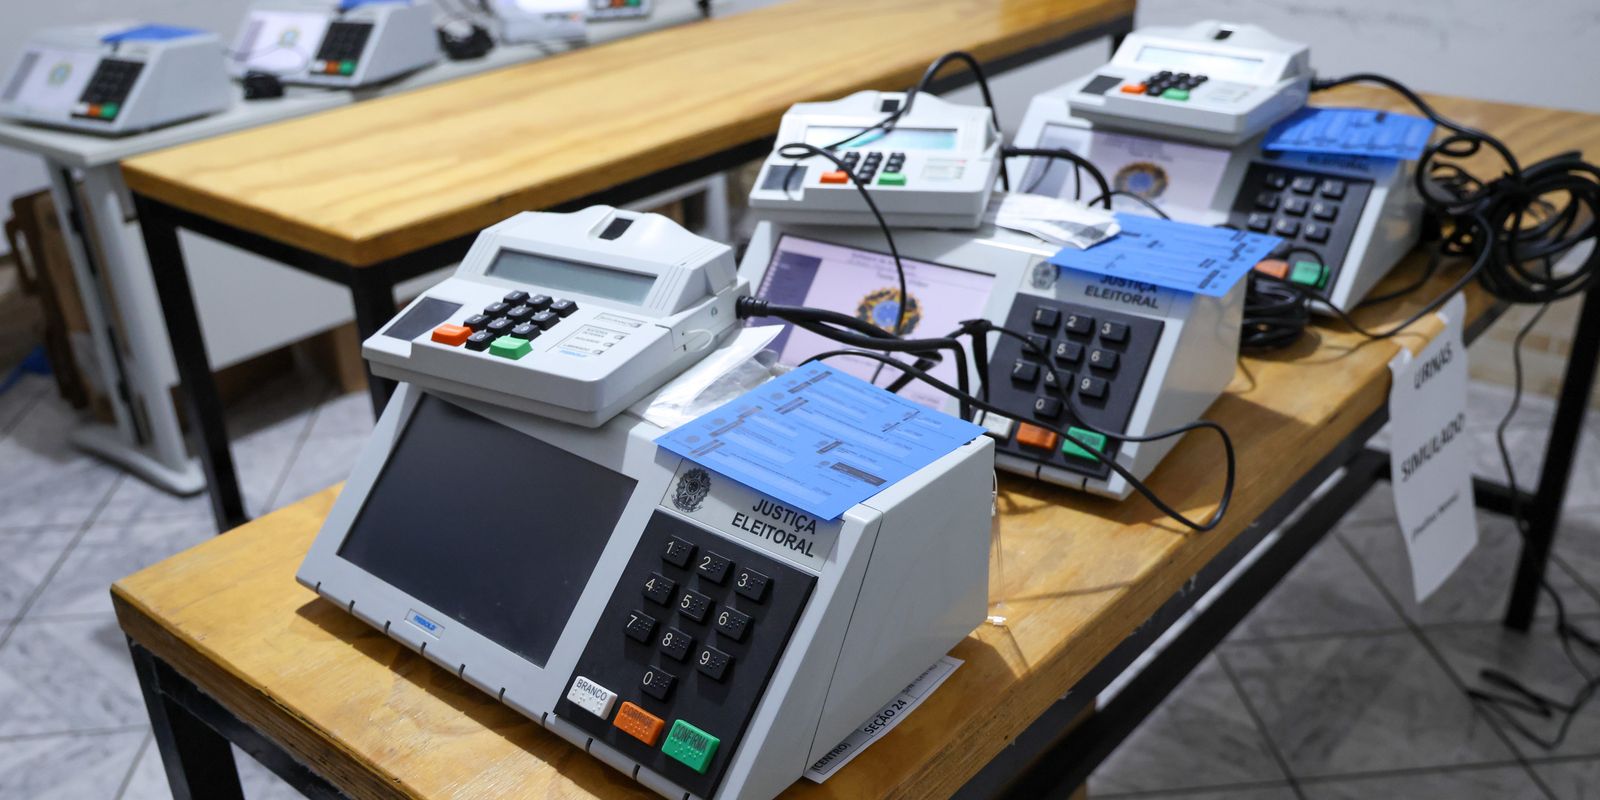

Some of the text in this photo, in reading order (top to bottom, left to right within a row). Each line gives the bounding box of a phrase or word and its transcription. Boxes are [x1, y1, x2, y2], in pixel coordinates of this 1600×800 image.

[1084, 285, 1159, 309] ELEITORAL
[1035, 309, 1111, 335] 1 2 3
[1013, 362, 1023, 373] 7
[1080, 378, 1090, 390] 9
[1091, 351, 1101, 363] 6
[1413, 341, 1453, 389] URNAS
[1035, 398, 1045, 410] 0
[1400, 413, 1465, 483] SIMULADO
[731, 512, 815, 559] ELEITORAL
[752, 498, 818, 535] JUSTIÇA
[666, 541, 748, 588] 1 2 3
[645, 577, 729, 626] 4 5 6
[626, 615, 710, 665] 7 8 9
[643, 671, 653, 686] 0
[575, 678, 608, 701] BRANCO
[672, 724, 708, 752] CONFIRMA
[812, 699, 908, 771] (CENTRO) SEÇÃO 24
